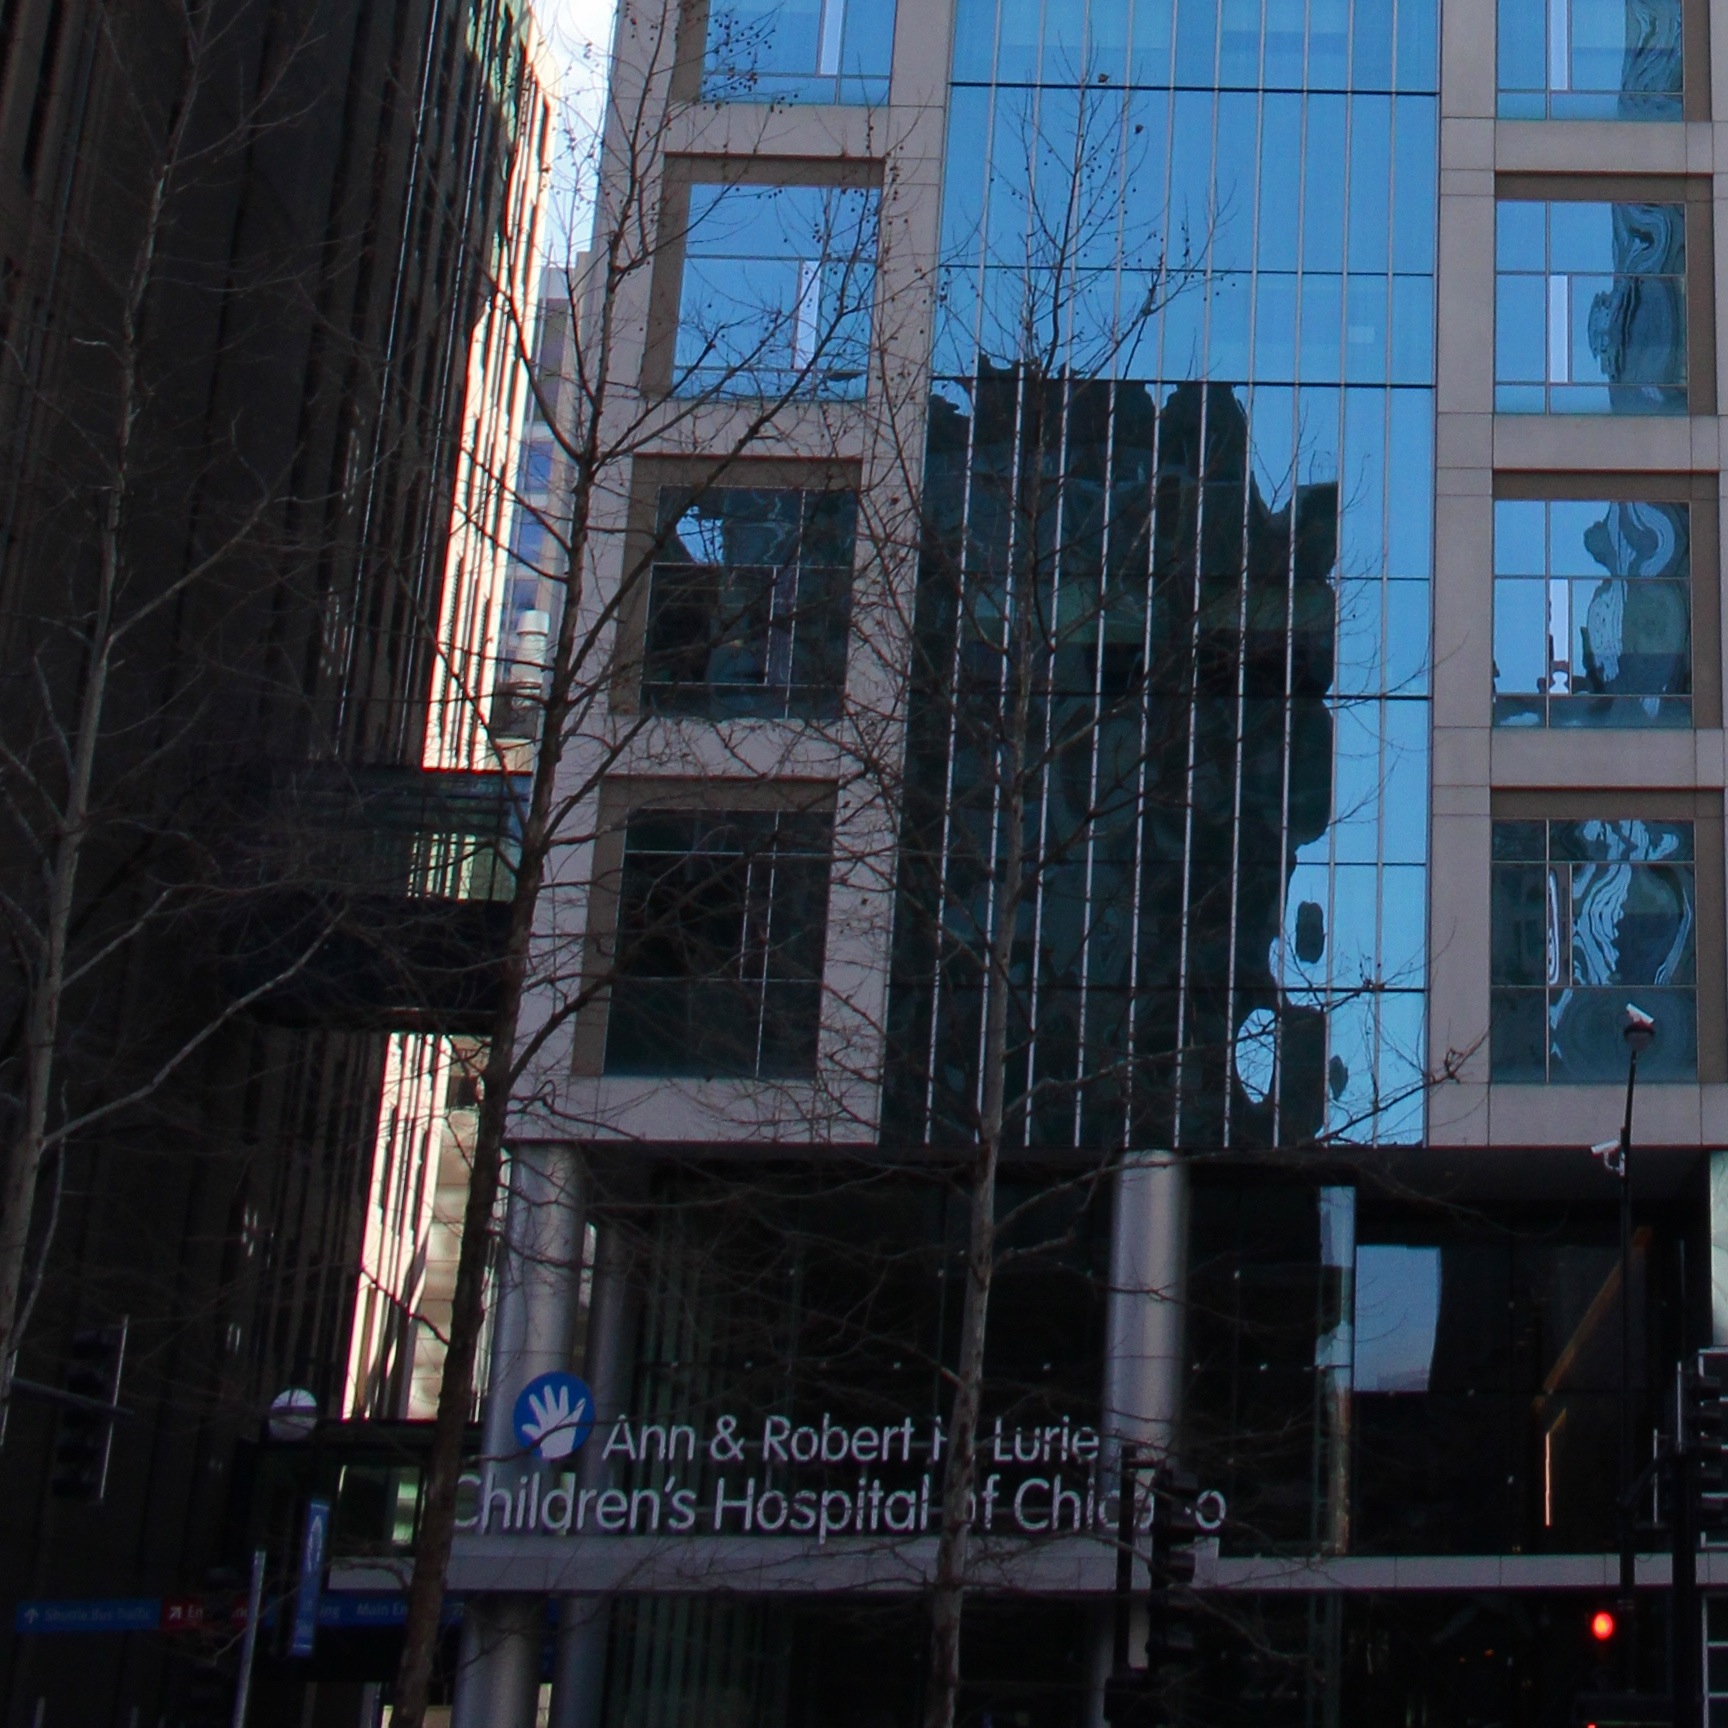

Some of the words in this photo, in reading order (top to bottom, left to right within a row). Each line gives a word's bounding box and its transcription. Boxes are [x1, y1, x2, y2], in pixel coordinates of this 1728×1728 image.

[601, 1413, 696, 1461] Ann
[709, 1414, 746, 1463] &
[762, 1411, 915, 1463] Robert
[993, 1414, 1100, 1463] Lurie
[714, 1474, 929, 1545] Hospital
